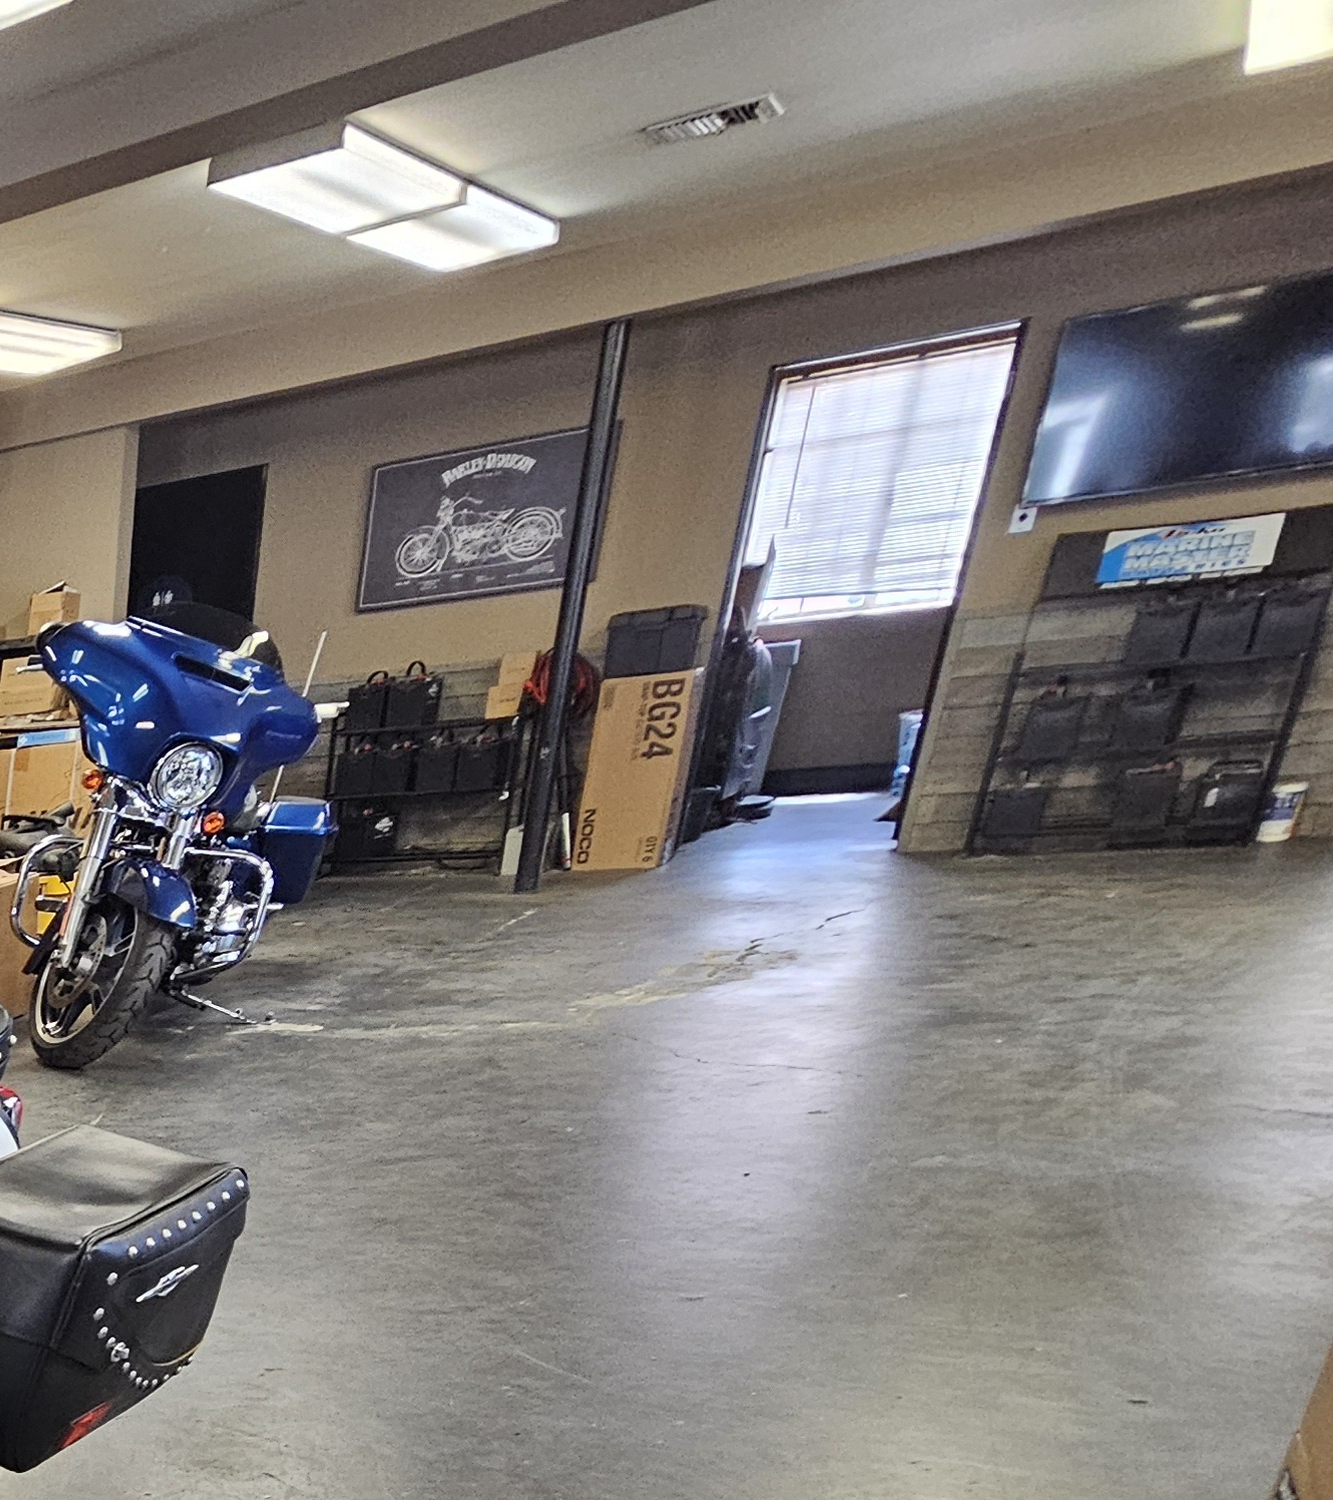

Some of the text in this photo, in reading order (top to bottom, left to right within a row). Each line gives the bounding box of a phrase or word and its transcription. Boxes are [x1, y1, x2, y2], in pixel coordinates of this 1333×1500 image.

[1124, 545, 1251, 570] MASTER
[1127, 531, 1255, 556] MARINE
[641, 677, 687, 760] BG24
[577, 809, 597, 864] NOCO
